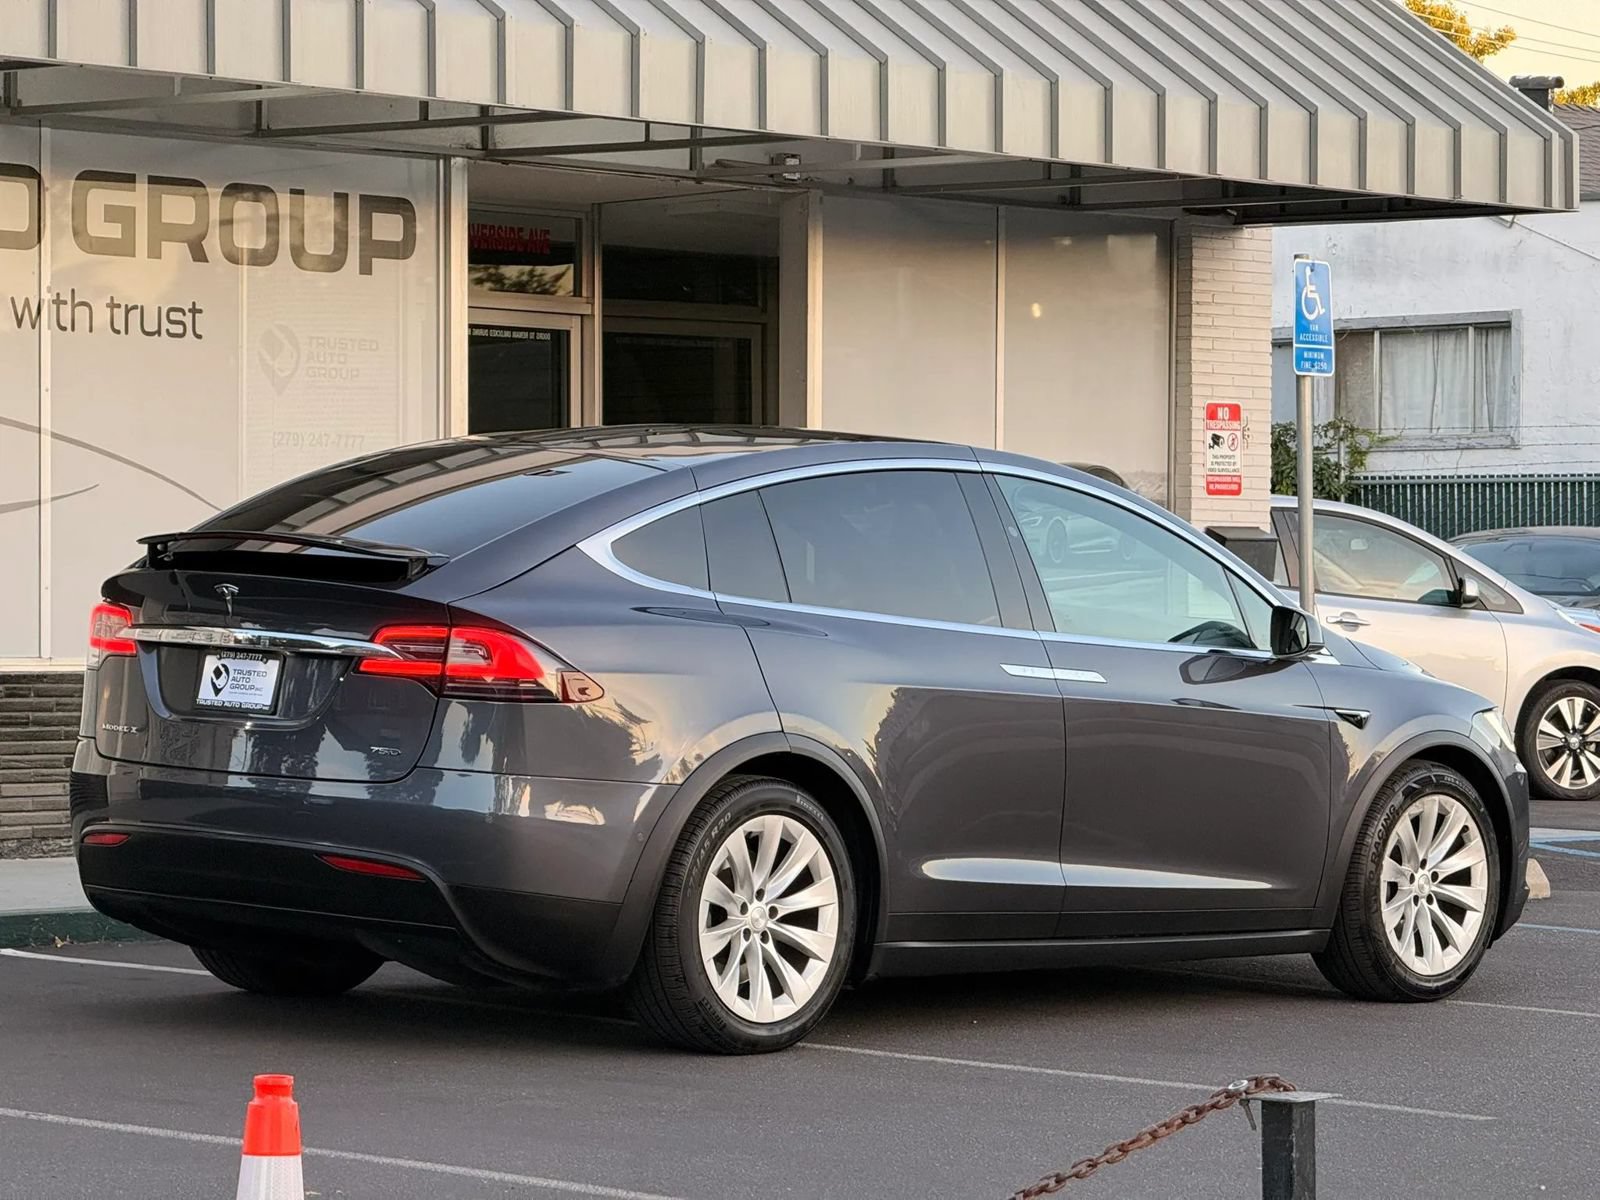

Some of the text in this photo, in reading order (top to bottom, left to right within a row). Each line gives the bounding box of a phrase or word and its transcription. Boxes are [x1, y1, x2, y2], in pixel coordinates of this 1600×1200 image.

[71, 169, 417, 276] GROUP
[10, 288, 204, 340] with trust
[305, 336, 379, 352] TRUSTED
[1300, 333, 1328, 342] ACCESSIBLE
[305, 352, 348, 365] AUTO
[1304, 351, 1324, 359] MINIMUM
[305, 366, 360, 381] GROUP
[1217, 407, 1230, 420] NO
[272, 431, 366, 450] (279) 247-7777
[221, 650, 262, 661] (279) 247-7777
[233, 669, 267, 678] TRUSTED
[230, 683, 255, 691] GROUP
[102, 723, 130, 732] MODEL
[711, 811, 732, 839] R20
